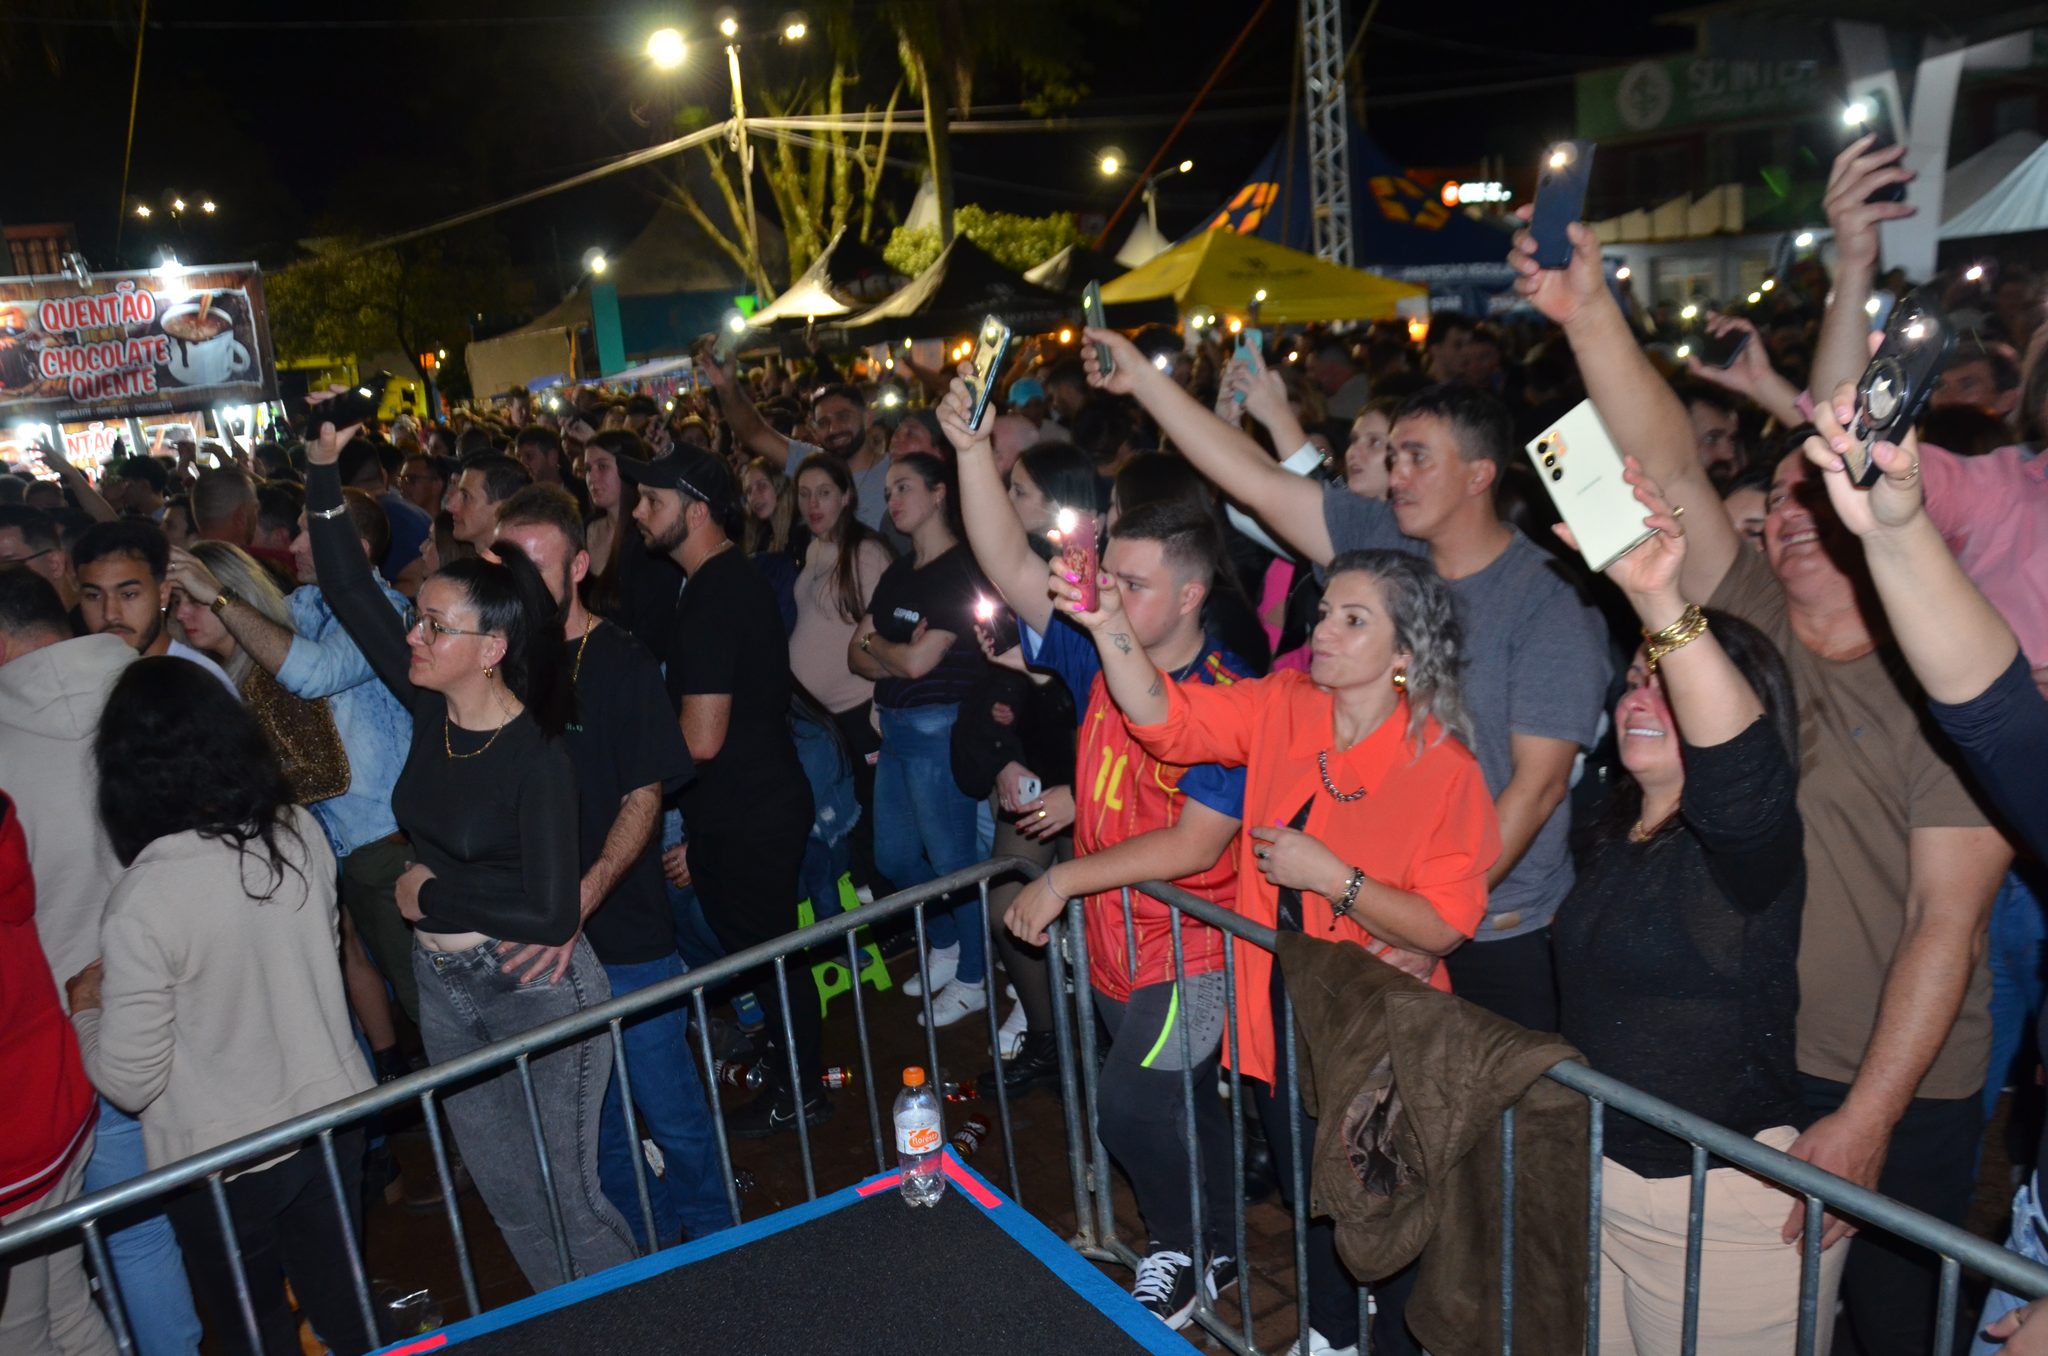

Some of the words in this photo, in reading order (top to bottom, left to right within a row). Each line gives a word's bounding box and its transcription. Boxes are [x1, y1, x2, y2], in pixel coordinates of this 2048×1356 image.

[41, 281, 155, 332] QUENTÃO
[42, 336, 170, 377] CHOCOLATE
[71, 368, 155, 400] QUENTE
